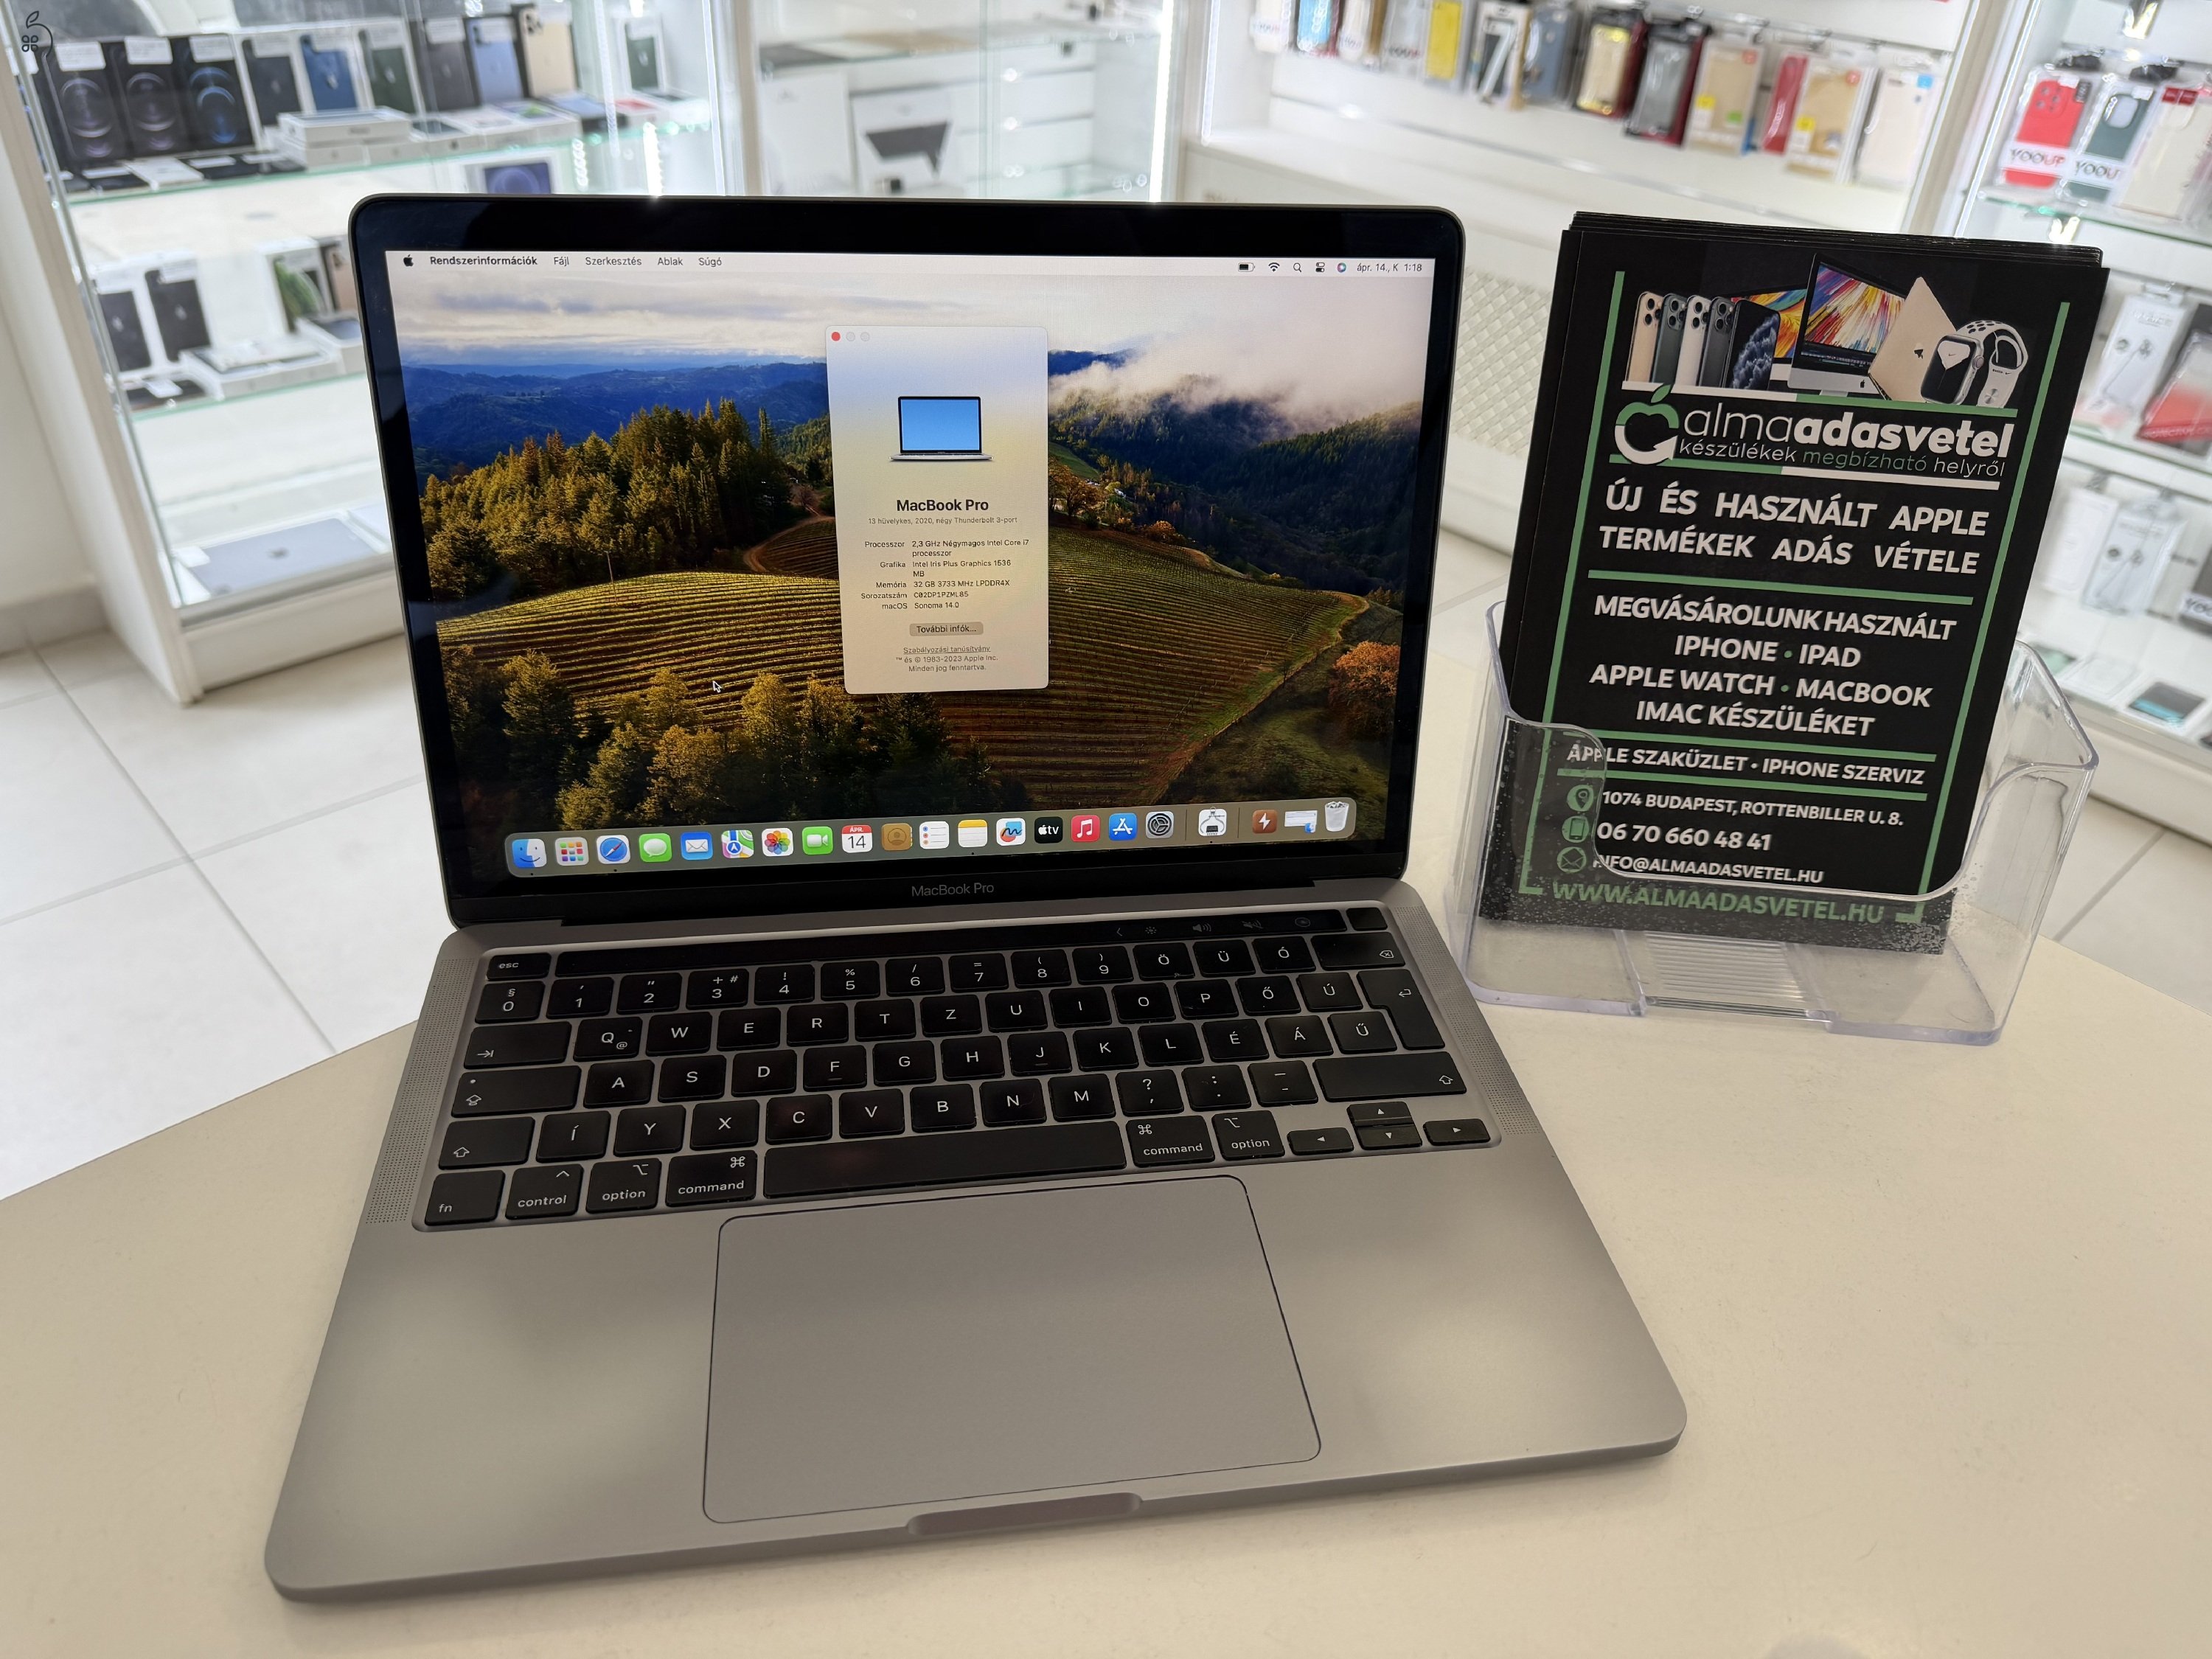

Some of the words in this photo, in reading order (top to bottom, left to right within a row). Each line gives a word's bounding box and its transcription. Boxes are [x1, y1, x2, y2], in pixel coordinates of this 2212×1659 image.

[430, 256, 538, 265] Rendszerinformációk
[554, 257, 569, 267] Fájl
[585, 257, 642, 265] Szerkesztés
[657, 257, 684, 265] Ablak
[698, 257, 723, 268] Súgó
[1357, 262, 1372, 274] ápr.
[1393, 263, 1399, 271] K
[1404, 263, 1422, 272] 1:18
[1679, 437, 1796, 463] készülékek
[1803, 446, 1927, 473] megbízható
[1933, 456, 2006, 478] helyről
[897, 498, 962, 512] MacBook
[965, 499, 989, 511] Pro
[1605, 477, 1644, 512] ÚJ
[1659, 476, 1698, 515] ÉS
[1715, 492, 1877, 529] HASZNÁLT
[1889, 505, 1989, 537] APPLE
[911, 540, 923, 549] 2,3
[942, 540, 985, 548] Négymagos
[1599, 524, 1756, 558] TERMÉKEK
[1771, 535, 1852, 566] ADÁS
[1874, 540, 1980, 574] VÉTELE
[1594, 594, 1824, 632] MEGVÁSÁROLUNK
[1824, 611, 1957, 641] HASZNÁLT
[916, 625, 948, 633] További
[1674, 634, 1778, 662] IPHONE
[1799, 643, 1861, 668] IPAD
[936, 664, 947, 672] jog
[1590, 663, 1674, 689] APPLE
[1680, 669, 1775, 696] WATCH
[1795, 678, 1934, 709] MACBOOK
[1636, 700, 1703, 725] IMAC
[1708, 701, 1876, 737] KÉSZÜLÉKET
[1567, 743, 1630, 763] APPLE
[1632, 748, 1749, 772] SZAKÜZLET
[1762, 758, 1839, 779] IPHONE
[1842, 764, 1925, 786] SZERVIZ
[1602, 790, 1642, 807] 1074
[1645, 794, 1739, 816] BUDAPEST,
[1740, 800, 1865, 824] ROTTENBILLER
[1868, 809, 1886, 824] U.
[1888, 811, 1904, 827] 8.
[848, 835, 866, 849] 14
[1597, 821, 1627, 841] 06
[1632, 824, 1660, 844] 70
[1664, 826, 1710, 846] 660
[1713, 830, 1742, 849] 48
[1746, 832, 1772, 852] 41
[911, 883, 970, 897] MacBook
[973, 883, 995, 894] Pro
[1551, 880, 1885, 925] WWW.ALMAADASVETEL.HU
[1218, 951, 1229, 961] Ü
[1279, 947, 1289, 958] Ó
[1158, 954, 1169, 964] Ö
[1038, 969, 1047, 978] 8
[1099, 965, 1108, 973] 9
[911, 977, 920, 986] 6
[975, 973, 983, 981] 7
[779, 985, 789, 993] 4
[846, 981, 855, 990] 5
[1324, 984, 1335, 995] Ú
[644, 993, 654, 1003] 2
[712, 989, 721, 998] 3
[1201, 994, 1210, 1003] P
[1263, 987, 1273, 999] Ő
[504, 1001, 514, 1011] 0
[577, 998, 582, 1007] 1
[1138, 997, 1149, 1006] O
[946, 1009, 956, 1019] Z
[1011, 1005, 1022, 1015] U
[813, 1018, 822, 1028] R
[880, 1014, 890, 1023] T
[672, 1027, 688, 1037] W
[744, 1023, 754, 1033] E
[1295, 1027, 1305, 1040] Á
[1356, 1023, 1368, 1035] Ű
[602, 1032, 613, 1043] Q
[1230, 1032, 1240, 1044] É
[1100, 1043, 1110, 1053] K
[1166, 1039, 1176, 1048] L
[967, 1051, 978, 1062] H
[1036, 1047, 1043, 1057] J
[831, 1062, 840, 1071] F
[899, 1057, 910, 1066] G
[686, 1071, 698, 1082] S
[758, 1066, 770, 1077] D
[612, 1077, 625, 1088] A
[1007, 1095, 1019, 1107] N
[1074, 1091, 1088, 1102] M
[865, 1106, 877, 1117] V
[937, 1101, 948, 1112] B
[793, 1112, 804, 1123] C
[644, 1123, 655, 1135] Y
[719, 1118, 731, 1130] X
[571, 1125, 579, 1140] Í
[1144, 1144, 1203, 1155] command
[1232, 1141, 1270, 1150] option
[678, 1180, 743, 1194] command
[518, 1195, 566, 1207] control
[602, 1190, 645, 1201] option
[439, 1204, 452, 1212] fn
